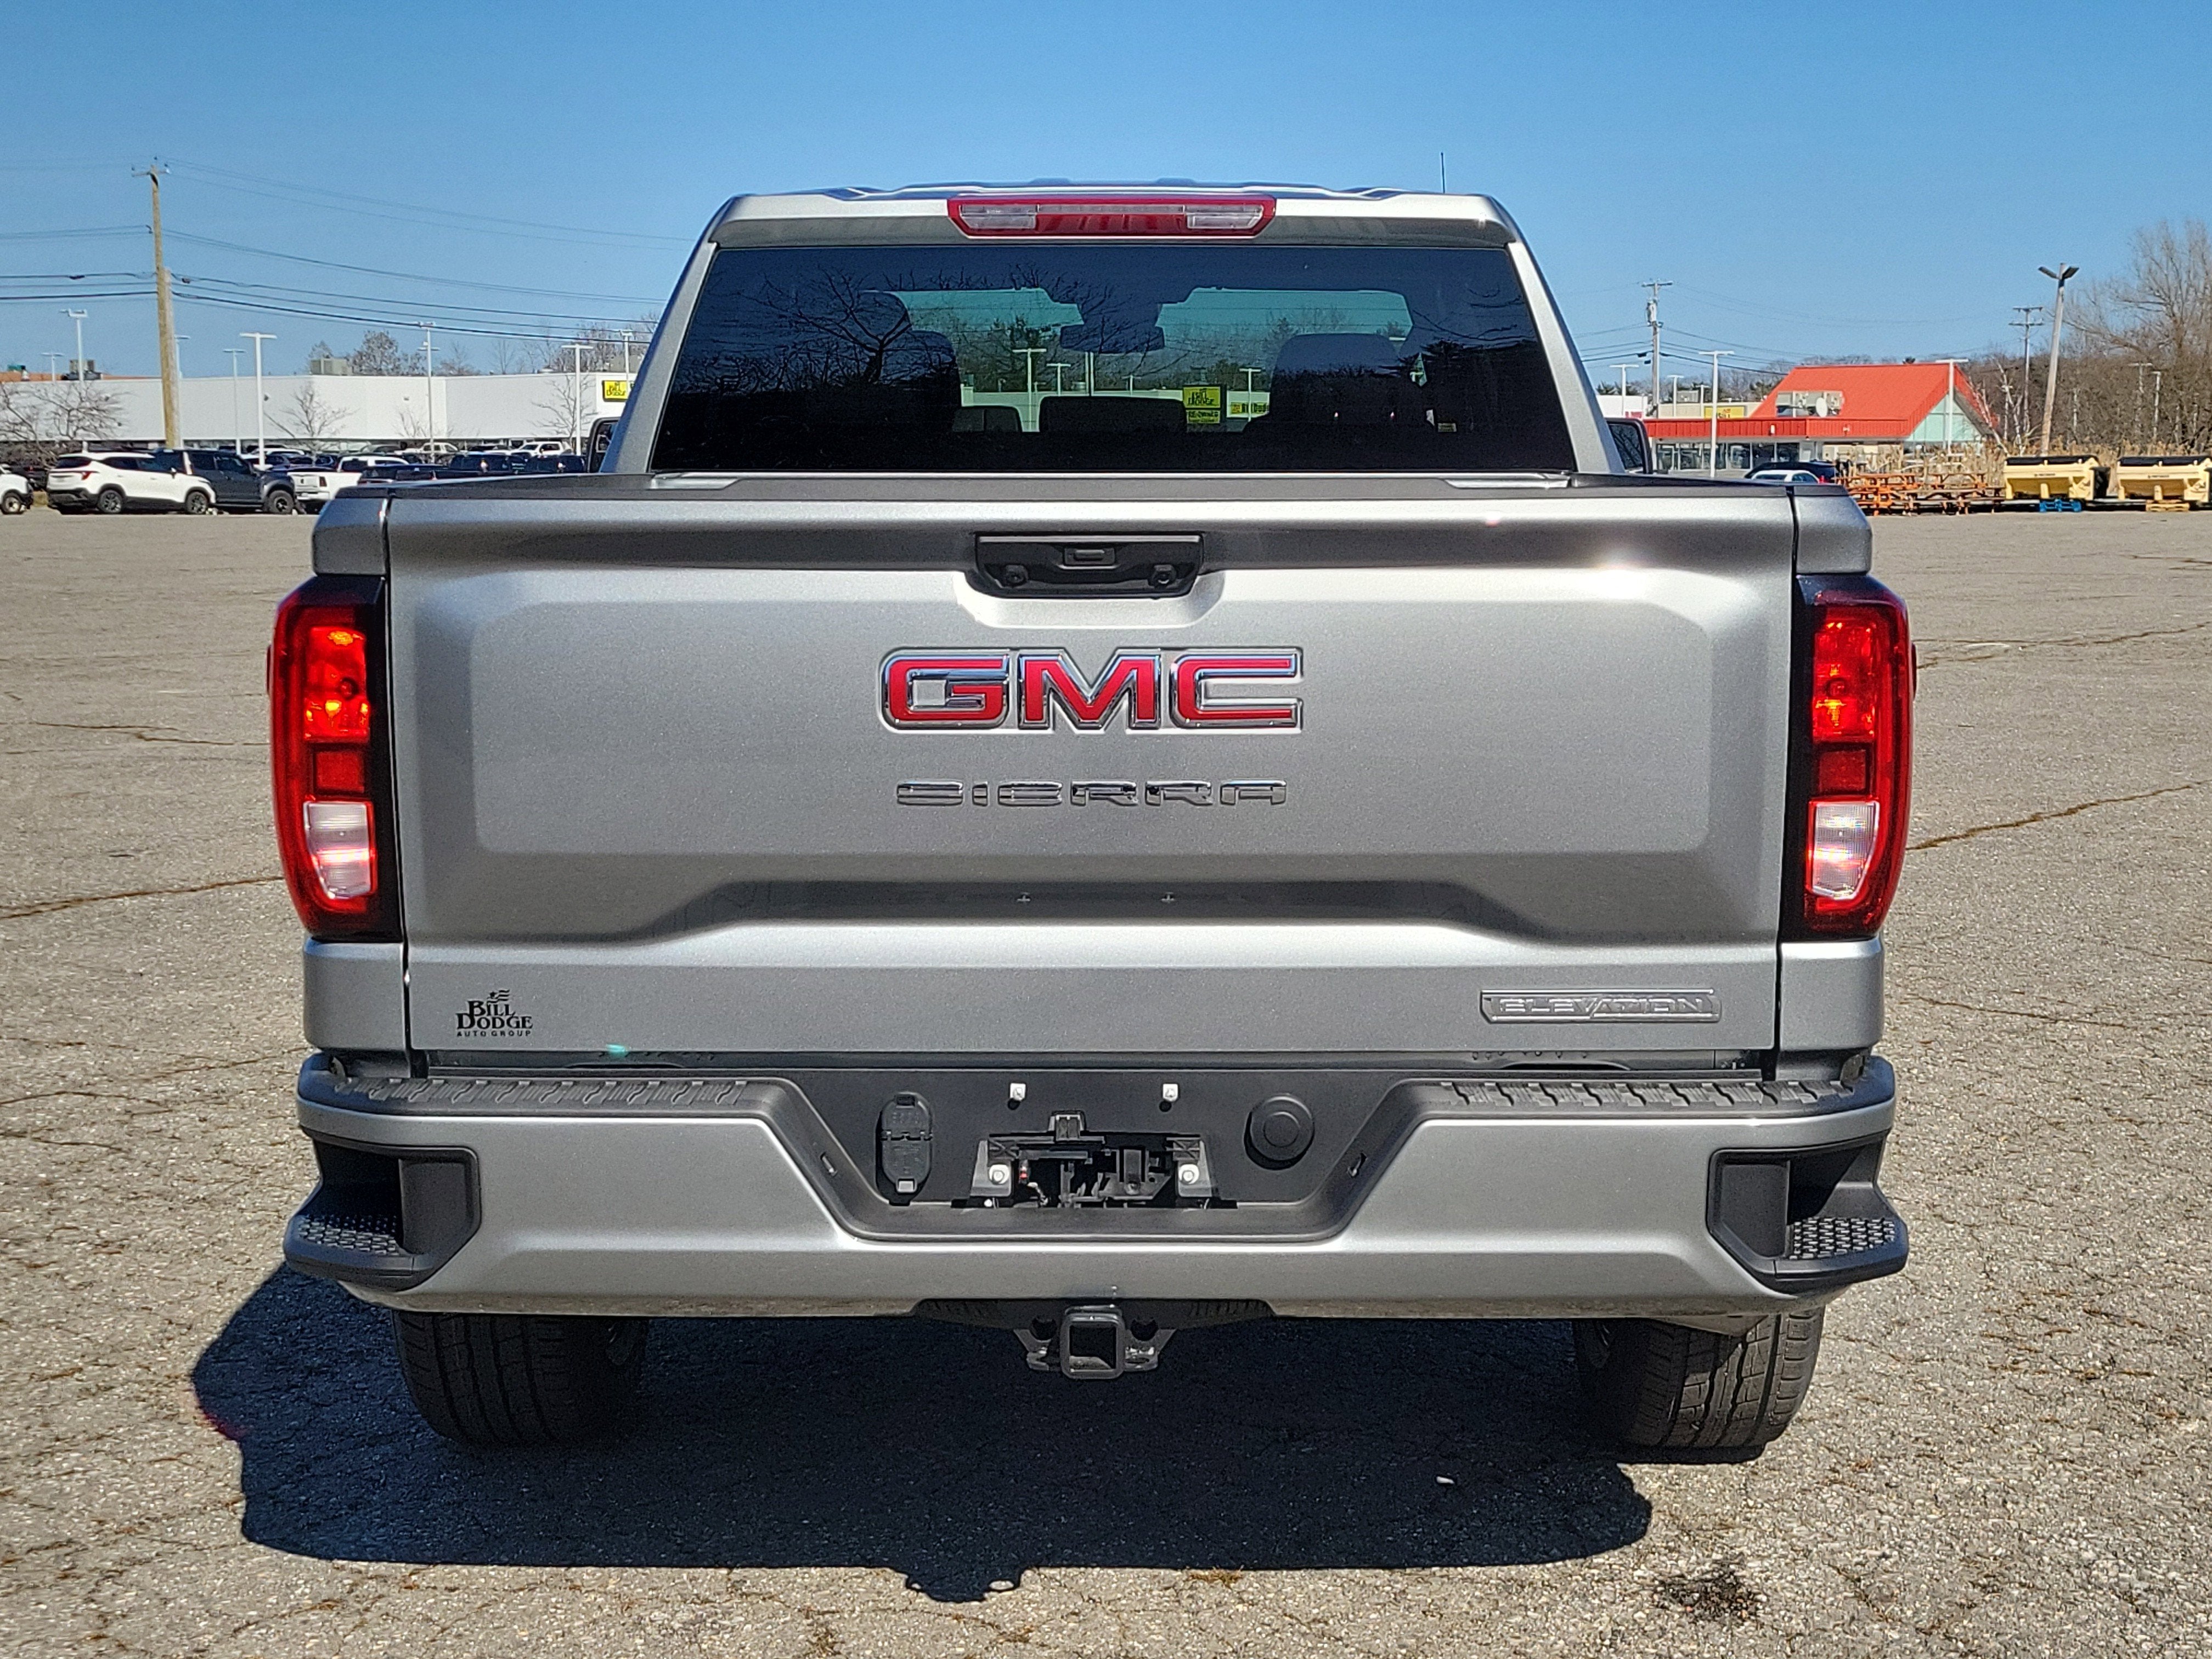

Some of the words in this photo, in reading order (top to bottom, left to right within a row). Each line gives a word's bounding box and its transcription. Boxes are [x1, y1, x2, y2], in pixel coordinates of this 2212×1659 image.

[882, 649, 1302, 733] GMC
[896, 779, 1288, 806] SIERRA
[467, 1000, 516, 1017] BILL
[1499, 997, 1704, 1014] ELEVATION
[455, 1013, 533, 1029] DODGE
